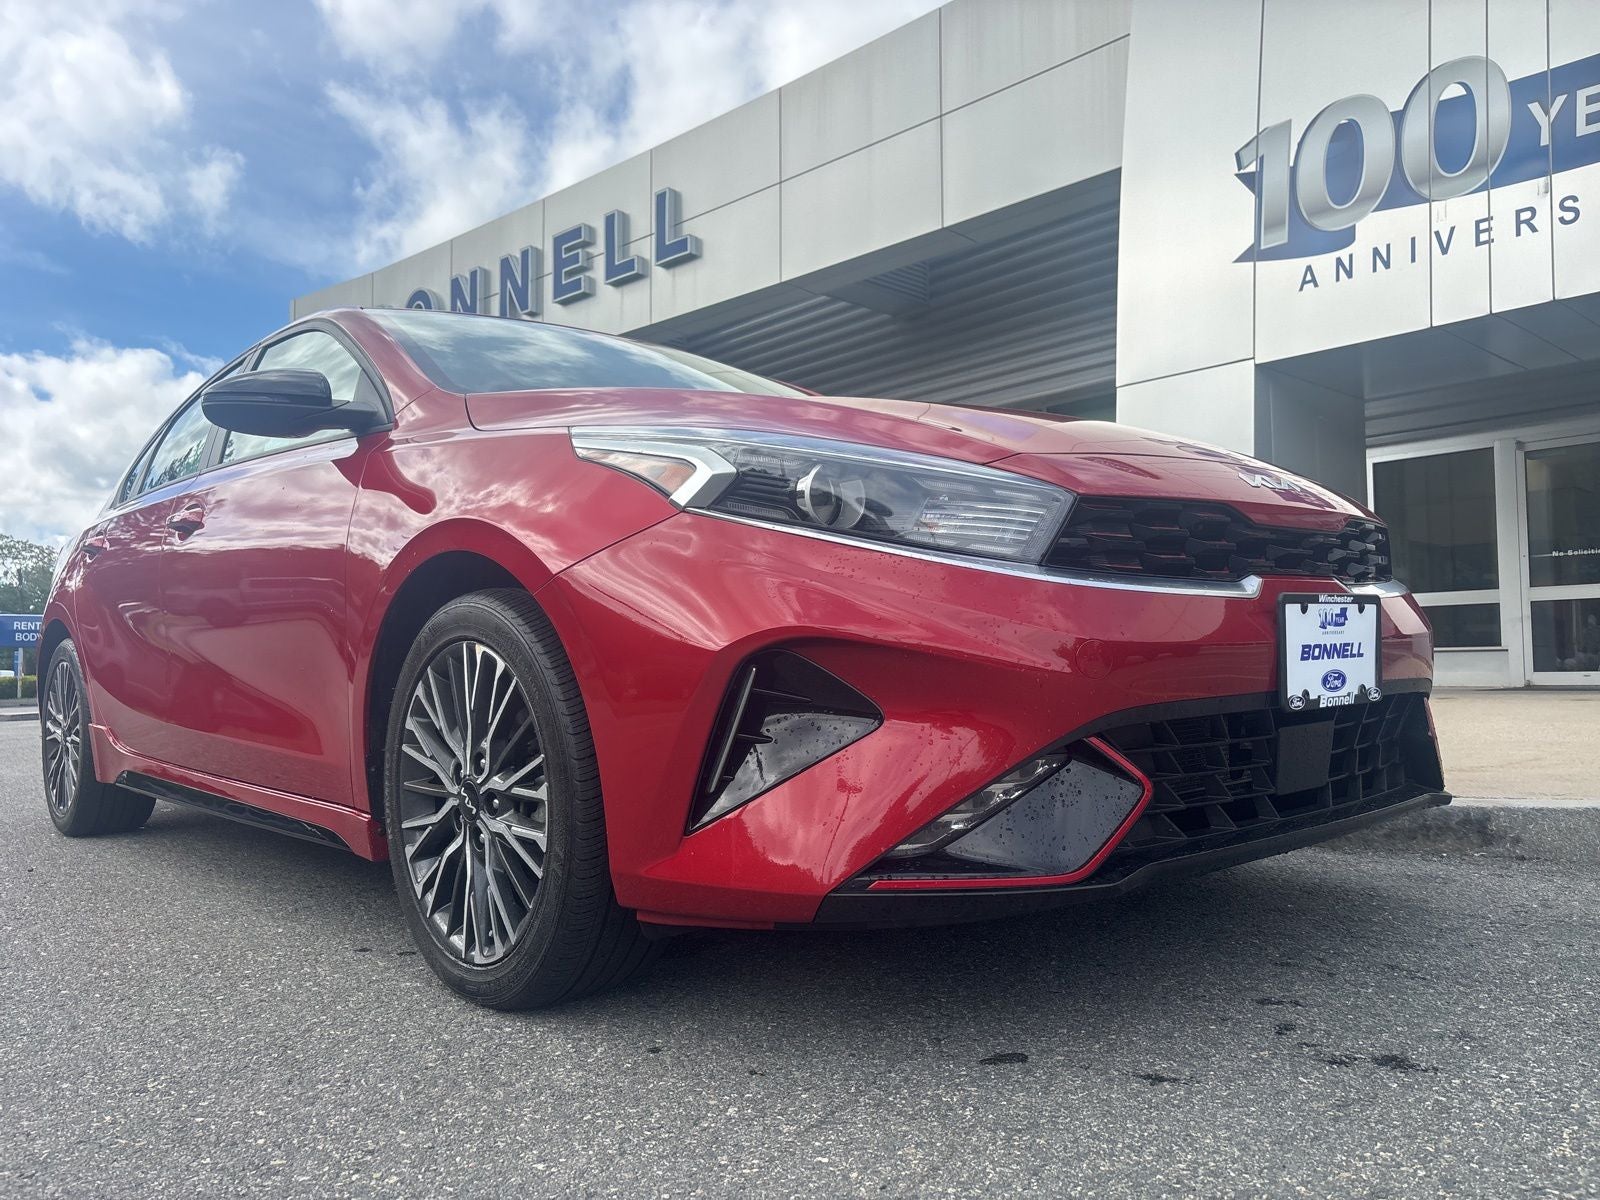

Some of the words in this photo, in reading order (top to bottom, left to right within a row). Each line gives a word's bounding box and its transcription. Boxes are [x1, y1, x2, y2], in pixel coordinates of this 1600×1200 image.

[1234, 55, 1512, 250] 100
[1298, 194, 1581, 292] ANNIVERS
[1318, 594, 1354, 603] Winchester
[1300, 642, 1364, 661] BONNELL
[1325, 672, 1343, 689] Ford
[1319, 691, 1355, 708] Bonnell
